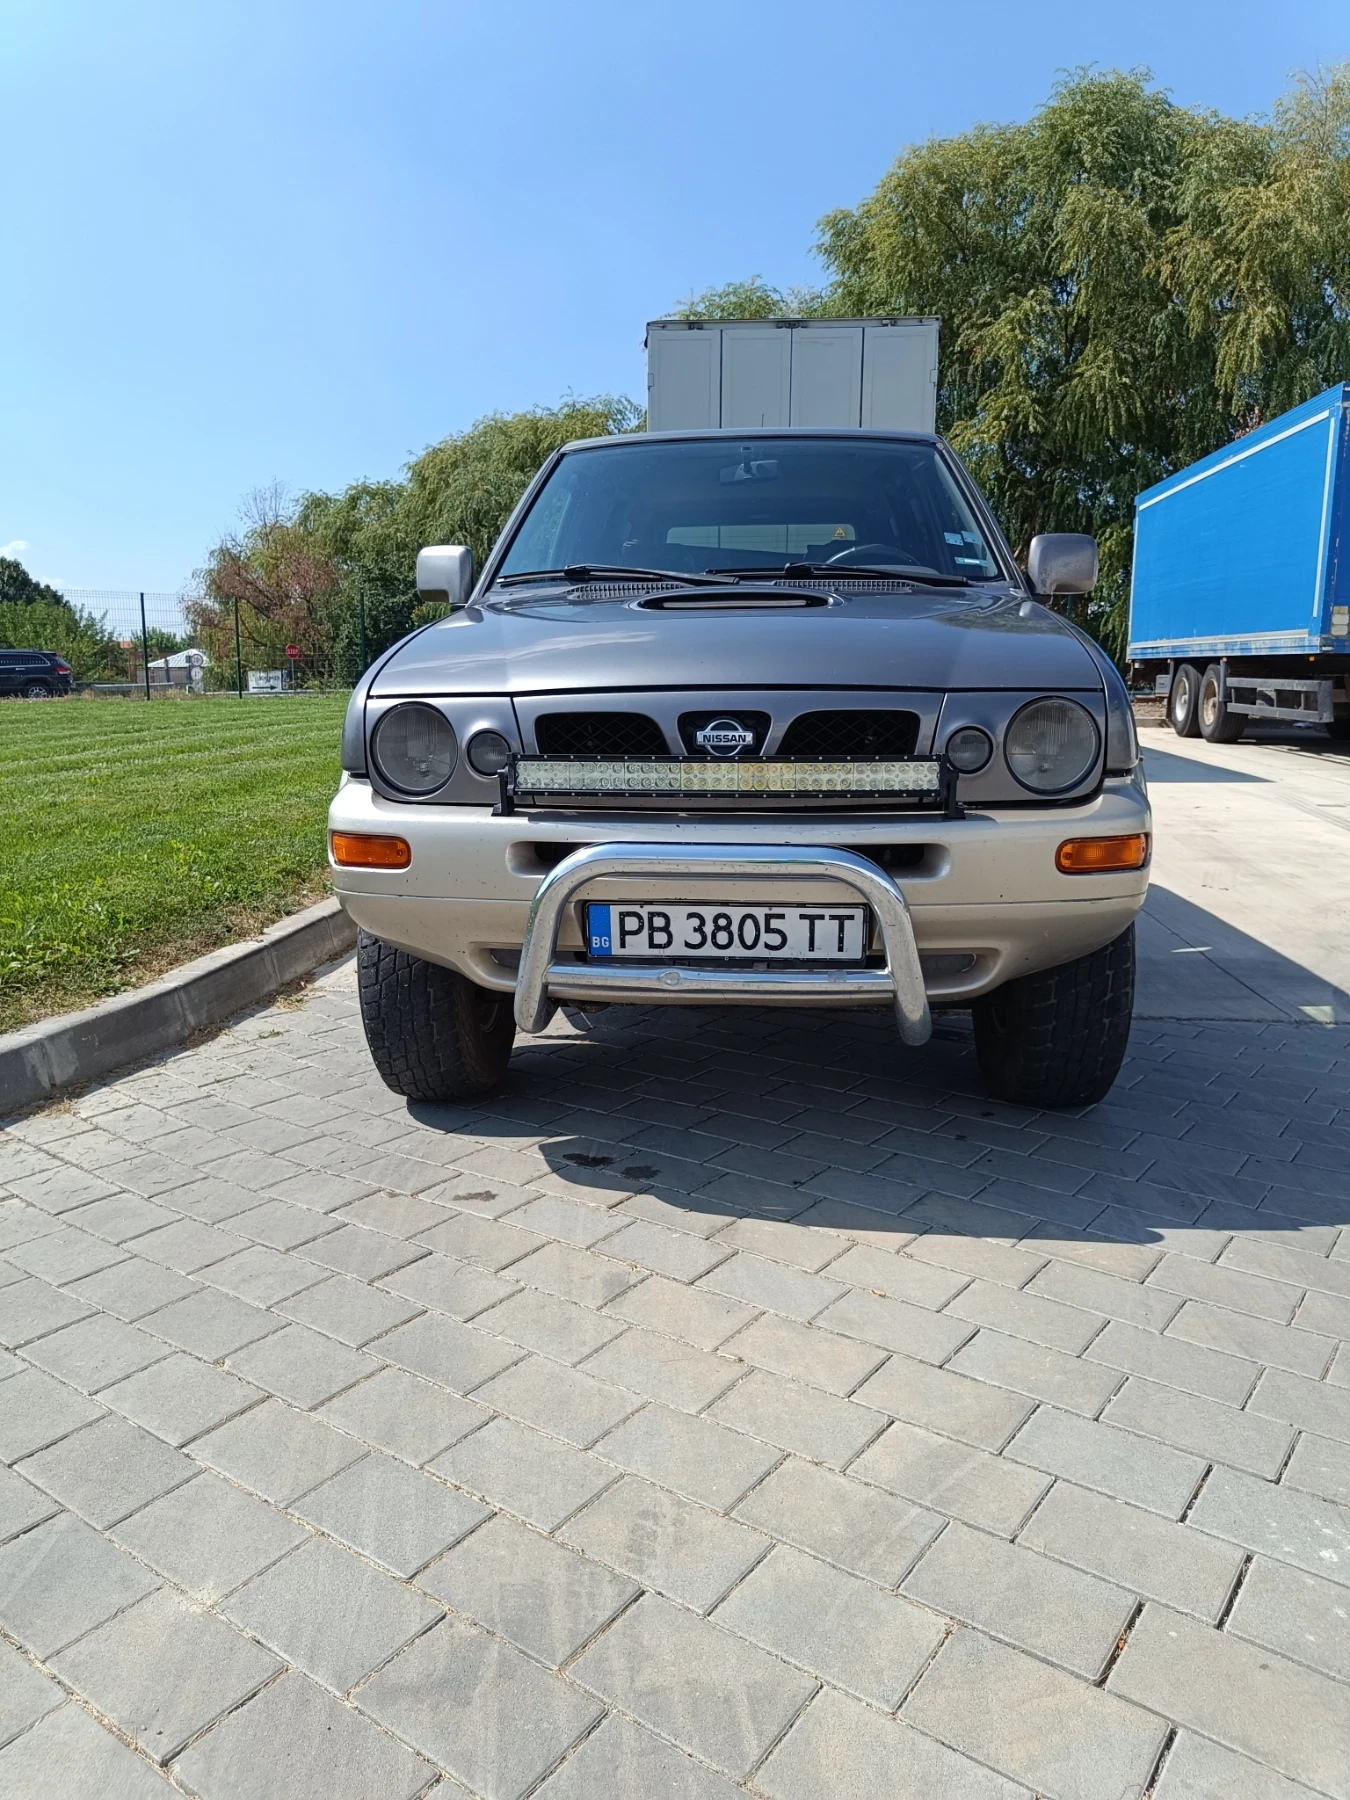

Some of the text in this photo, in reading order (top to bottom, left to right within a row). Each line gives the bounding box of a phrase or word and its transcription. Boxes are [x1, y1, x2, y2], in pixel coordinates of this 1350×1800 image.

[702, 734, 747, 743] NISSAN
[618, 911, 855, 953] PB 3805 TT
[592, 936, 610, 948] BG
